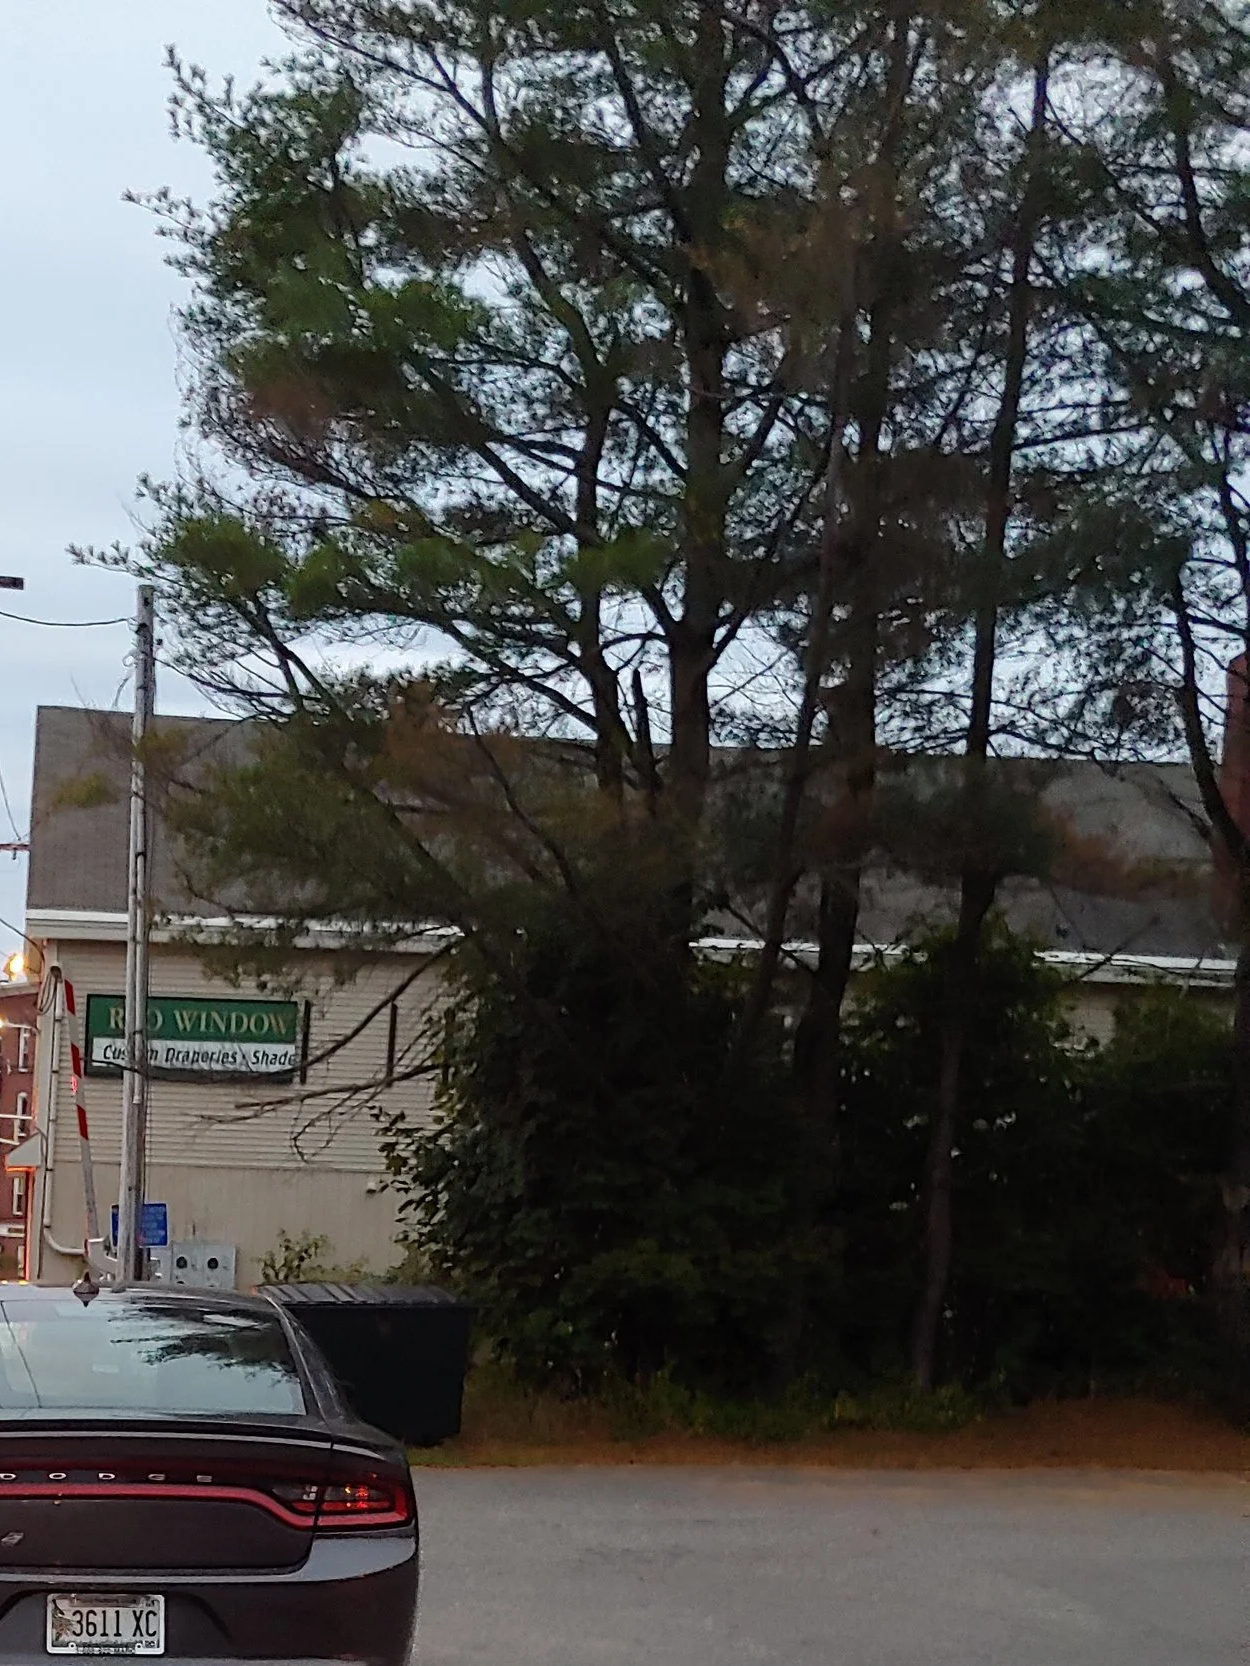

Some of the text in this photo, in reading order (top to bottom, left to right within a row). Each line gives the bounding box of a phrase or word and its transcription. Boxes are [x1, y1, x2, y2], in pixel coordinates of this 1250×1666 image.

[174, 1009, 291, 1035] WINDOW
[103, 1044, 158, 1062] Cusm
[0, 1472, 213, 1483] DODGE
[71, 1609, 158, 1637] 3611 XC
